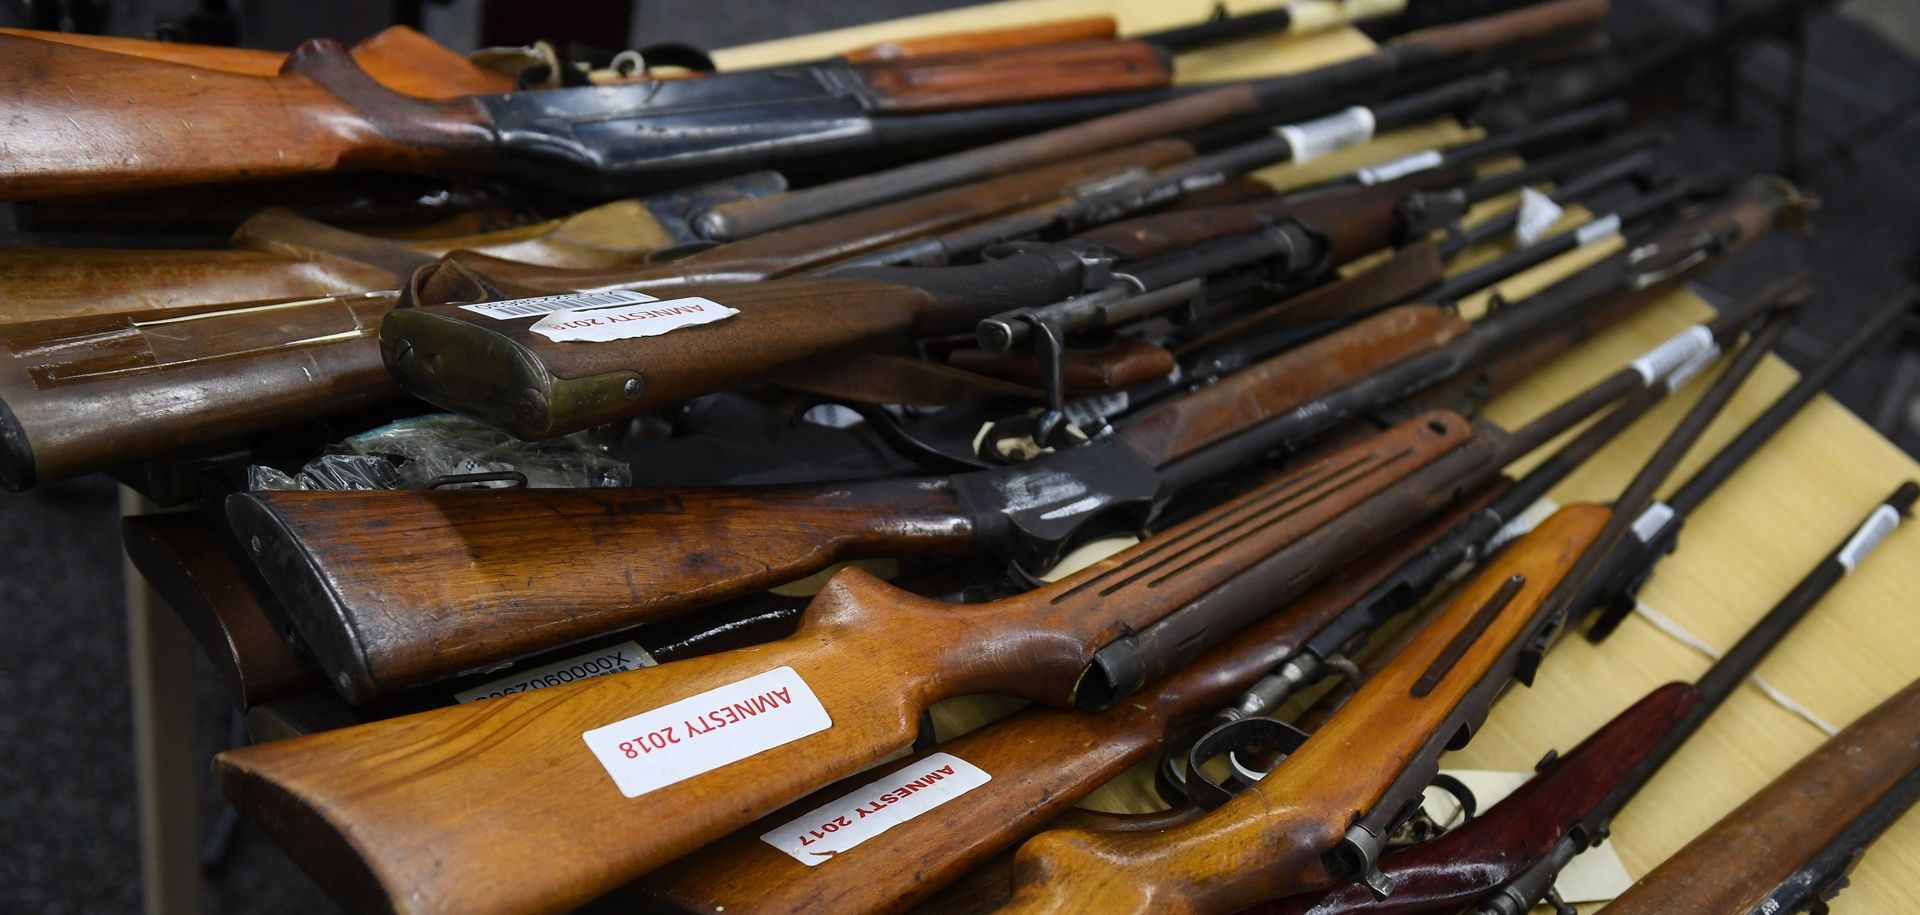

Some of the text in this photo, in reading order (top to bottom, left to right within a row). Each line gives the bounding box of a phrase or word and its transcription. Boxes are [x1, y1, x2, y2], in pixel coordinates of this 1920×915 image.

[607, 304, 705, 323] AMNESTY
[618, 687, 792, 759] AMNESTY 2018
[799, 764, 955, 846] AMNESTY 2017
